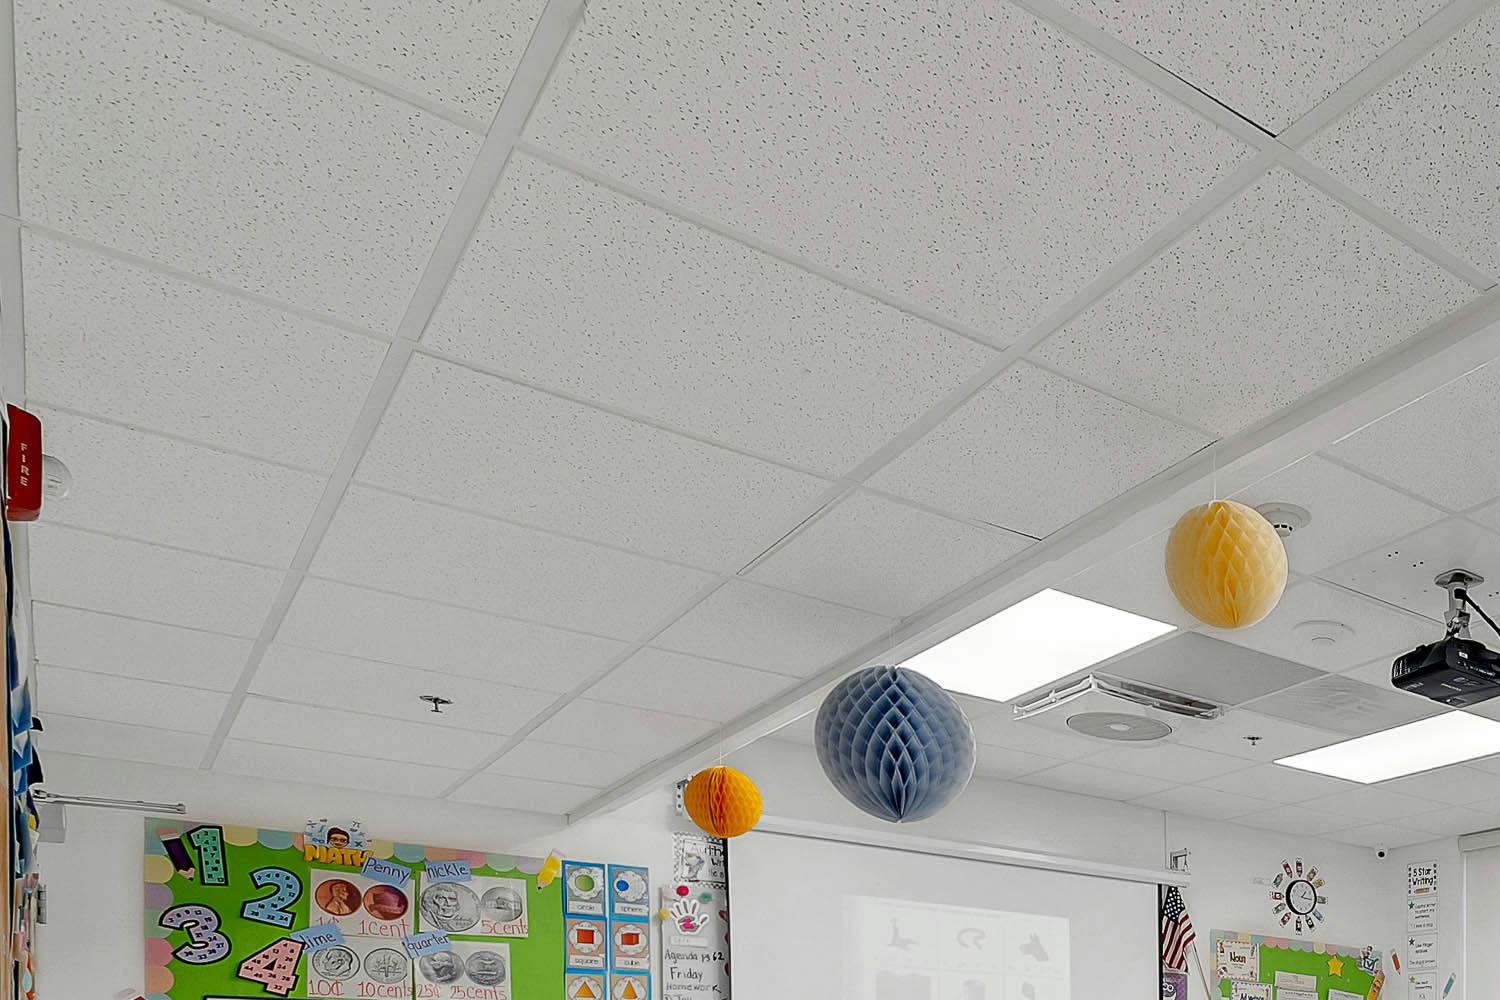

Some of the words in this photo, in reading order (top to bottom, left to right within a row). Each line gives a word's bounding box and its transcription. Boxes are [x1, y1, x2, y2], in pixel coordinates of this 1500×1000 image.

[187, 825, 229, 886] 1
[364, 858, 409, 884] Penny
[427, 863, 469, 880] nickle
[240, 866, 303, 930] 2
[158, 903, 232, 965] 3
[407, 935, 449, 957] quarter
[236, 937, 306, 996] 4
[713, 950, 725, 961] 62
[670, 966, 703, 982] Friday
